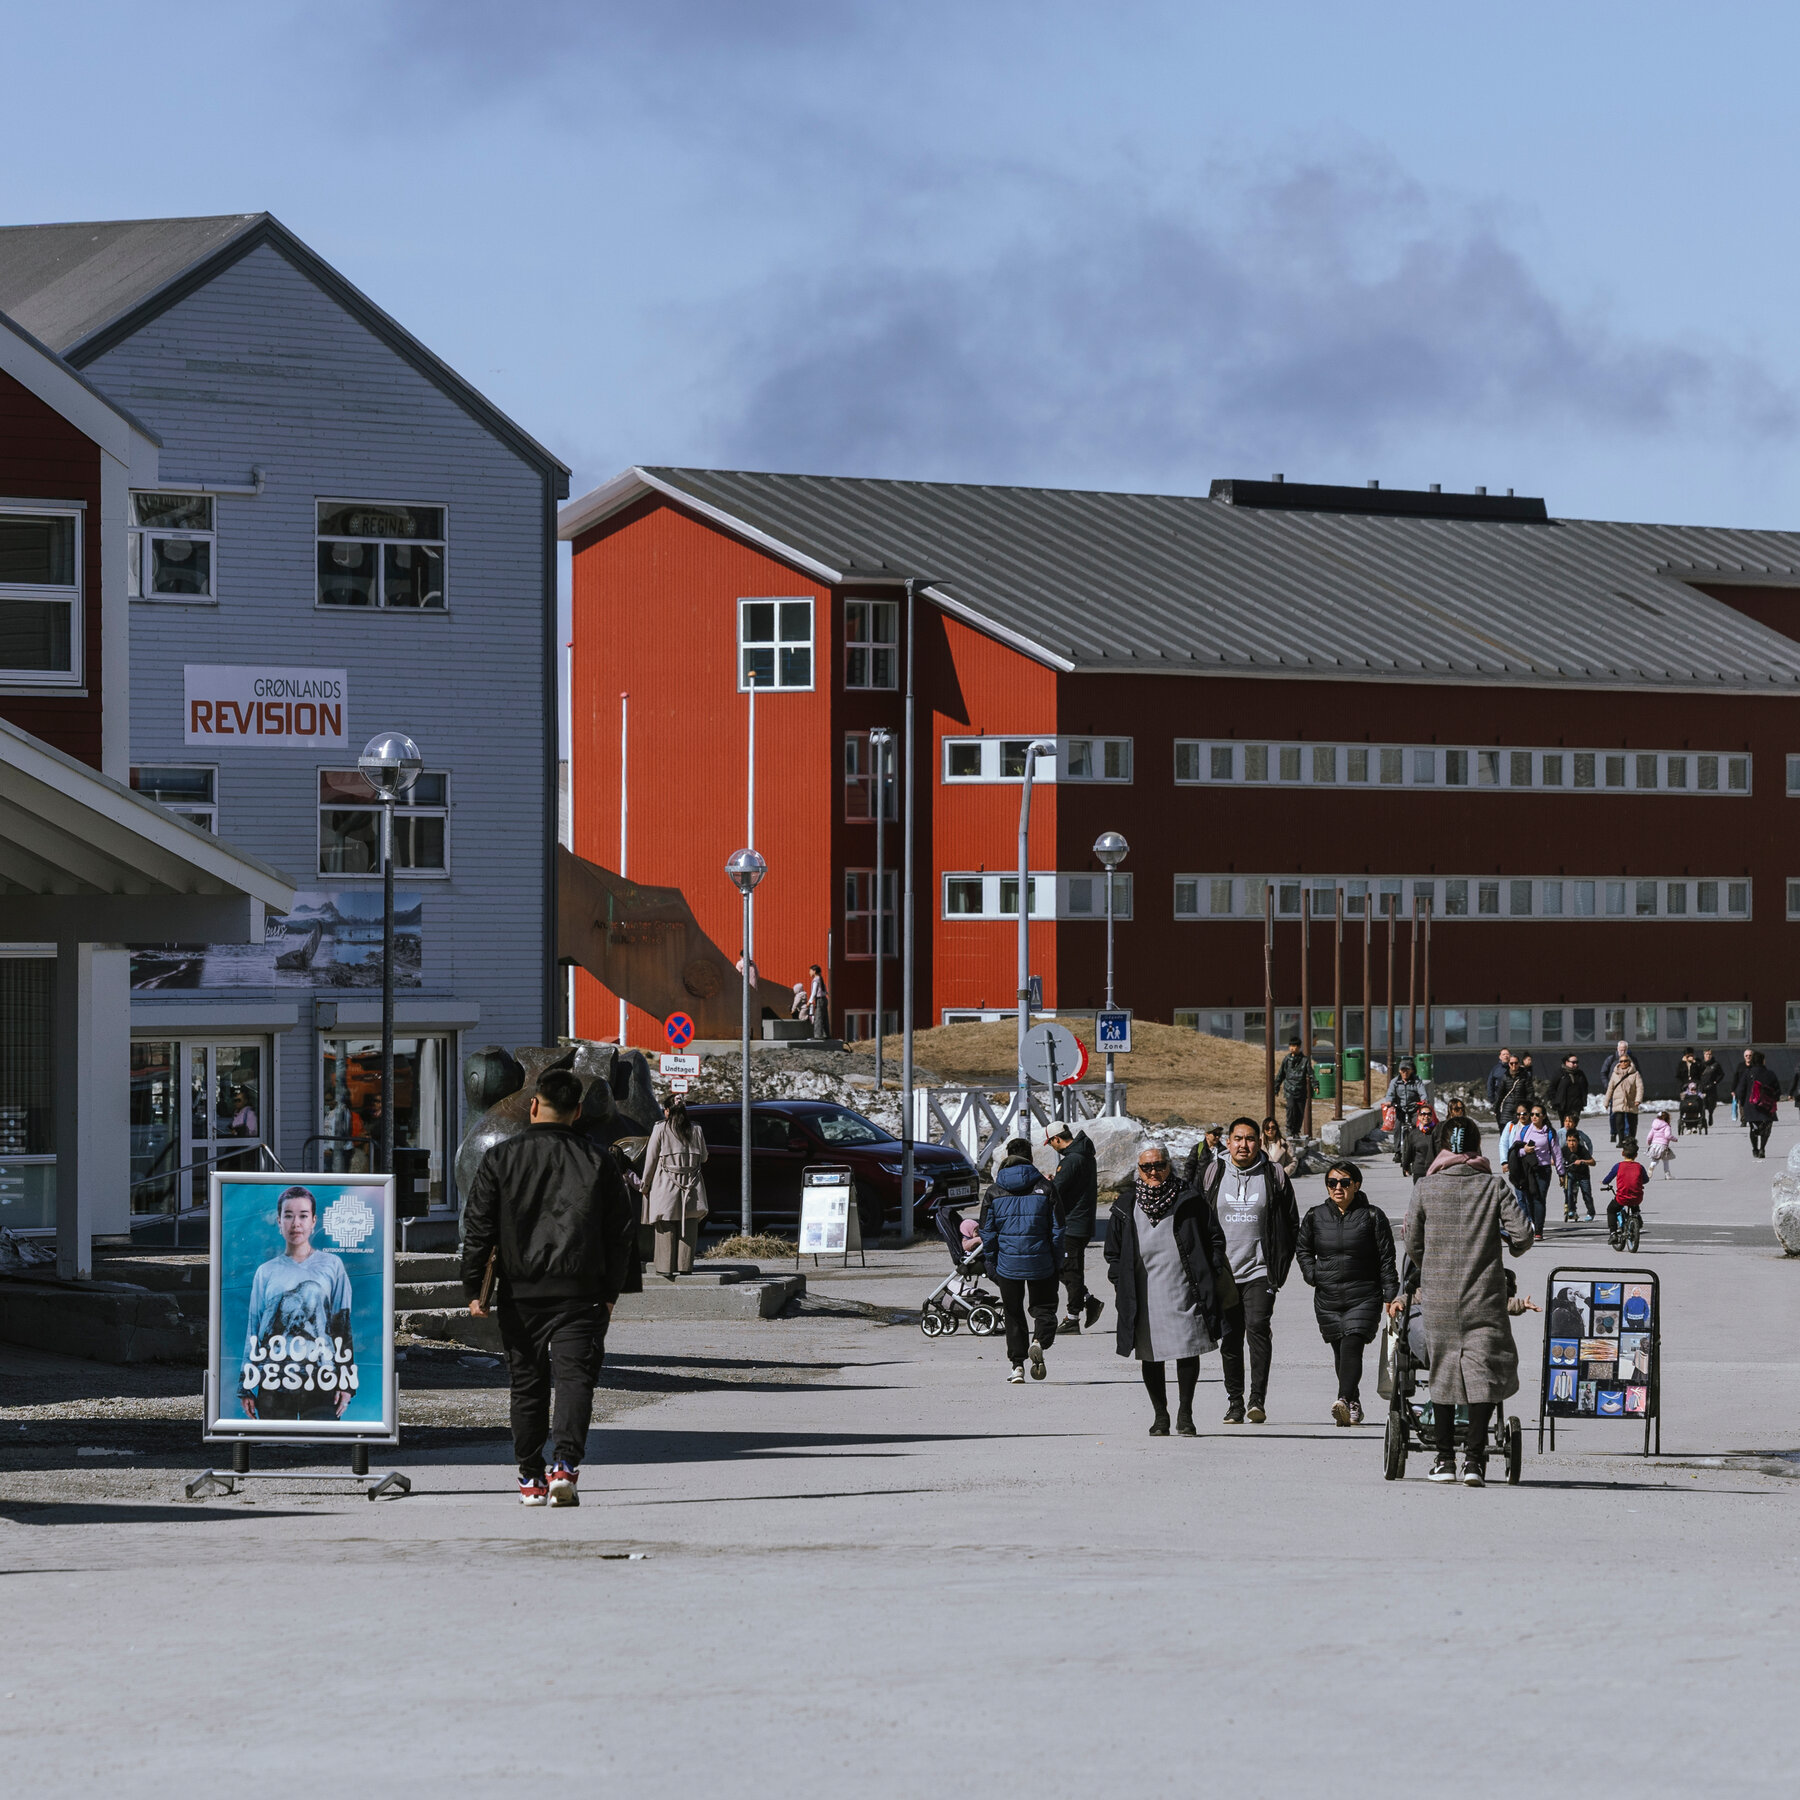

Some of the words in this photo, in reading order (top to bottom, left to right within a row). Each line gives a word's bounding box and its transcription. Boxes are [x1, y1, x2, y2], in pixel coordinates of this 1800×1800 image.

[363, 516, 405, 535] REGINA
[254, 678, 341, 698] GRØNLANDS
[191, 700, 341, 736] REVISION
[665, 1066, 695, 1074] Undtaget
[1225, 1212, 1258, 1222] adidas
[250, 1335, 352, 1362] LOCAL
[243, 1363, 359, 1391] DESIGN
